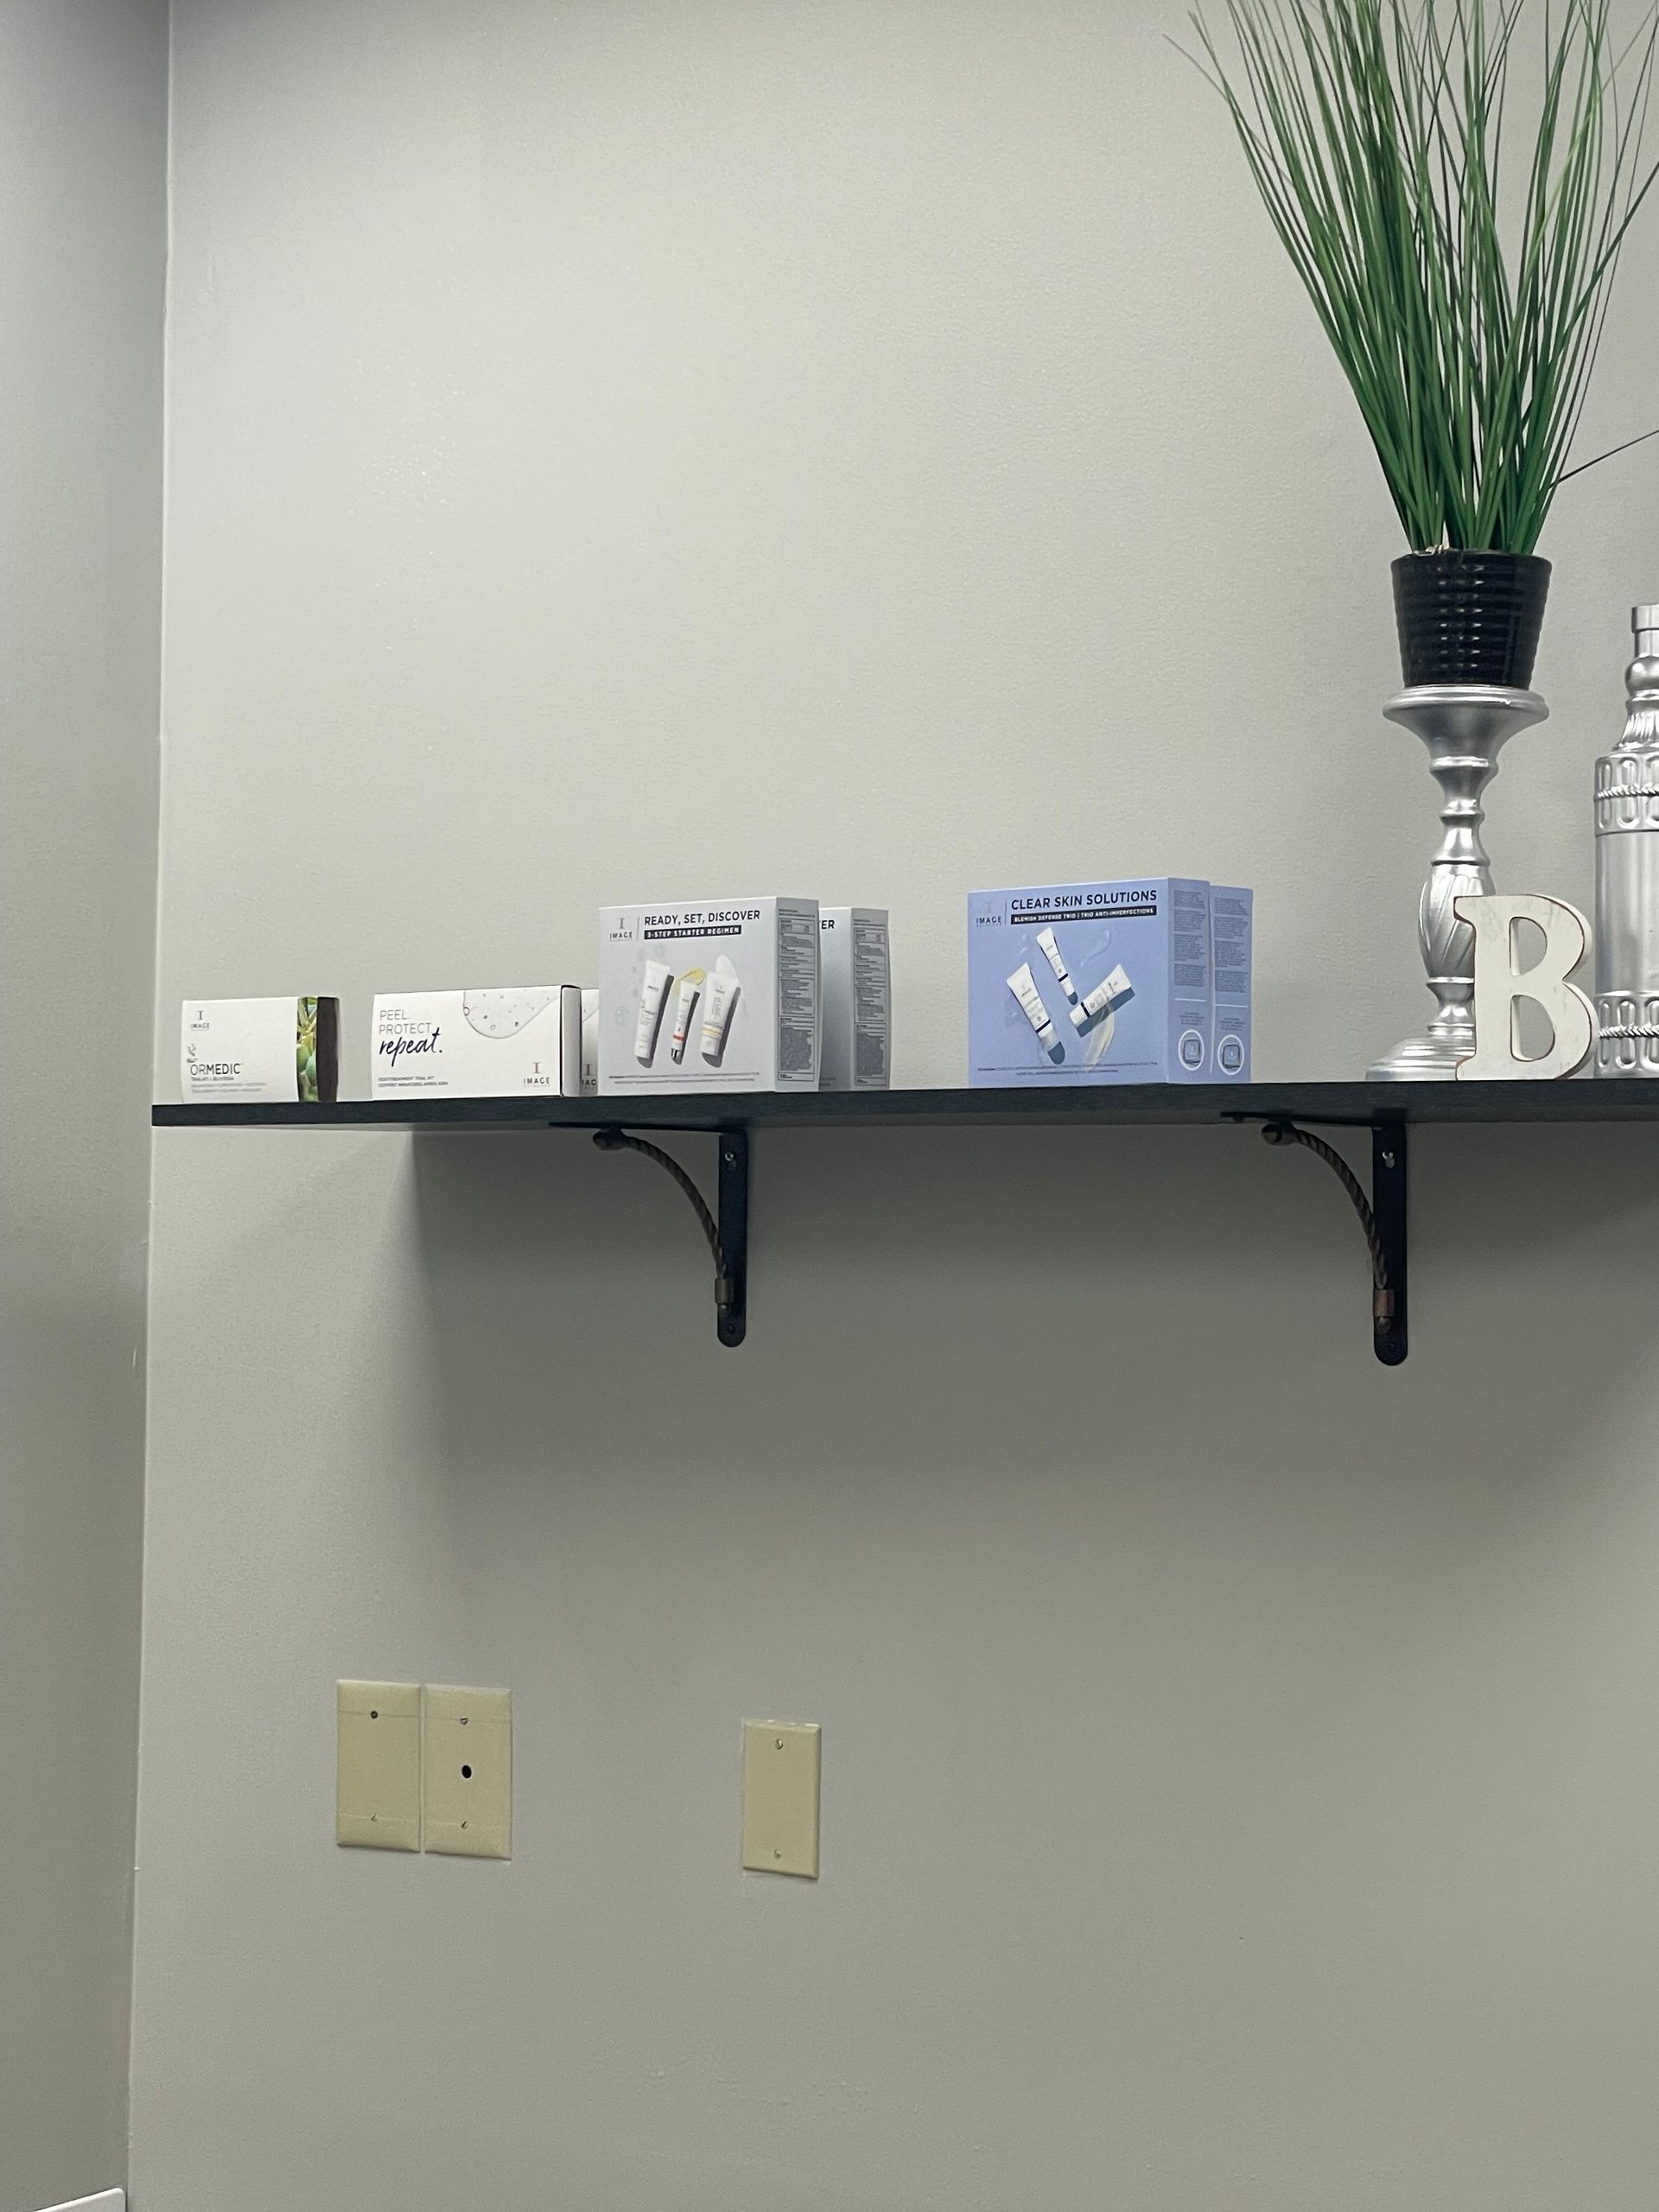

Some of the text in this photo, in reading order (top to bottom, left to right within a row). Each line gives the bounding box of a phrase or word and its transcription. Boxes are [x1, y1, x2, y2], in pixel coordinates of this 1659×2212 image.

[1011, 890, 1157, 910] CLEAR SKIN SOLUTIONS
[644, 910, 760, 925] READY, SET, DISCOVER
[1095, 908, 1154, 918] ANTI-IMPERFECTIONS
[819, 919, 836, 930] ER
[674, 928, 705, 937] STARTER
[707, 926, 741, 935] REGIMEN
[1453, 893, 1599, 1081] B
[378, 1027, 443, 1067] repeat.
[190, 1063, 241, 1075] ORMEDIC
